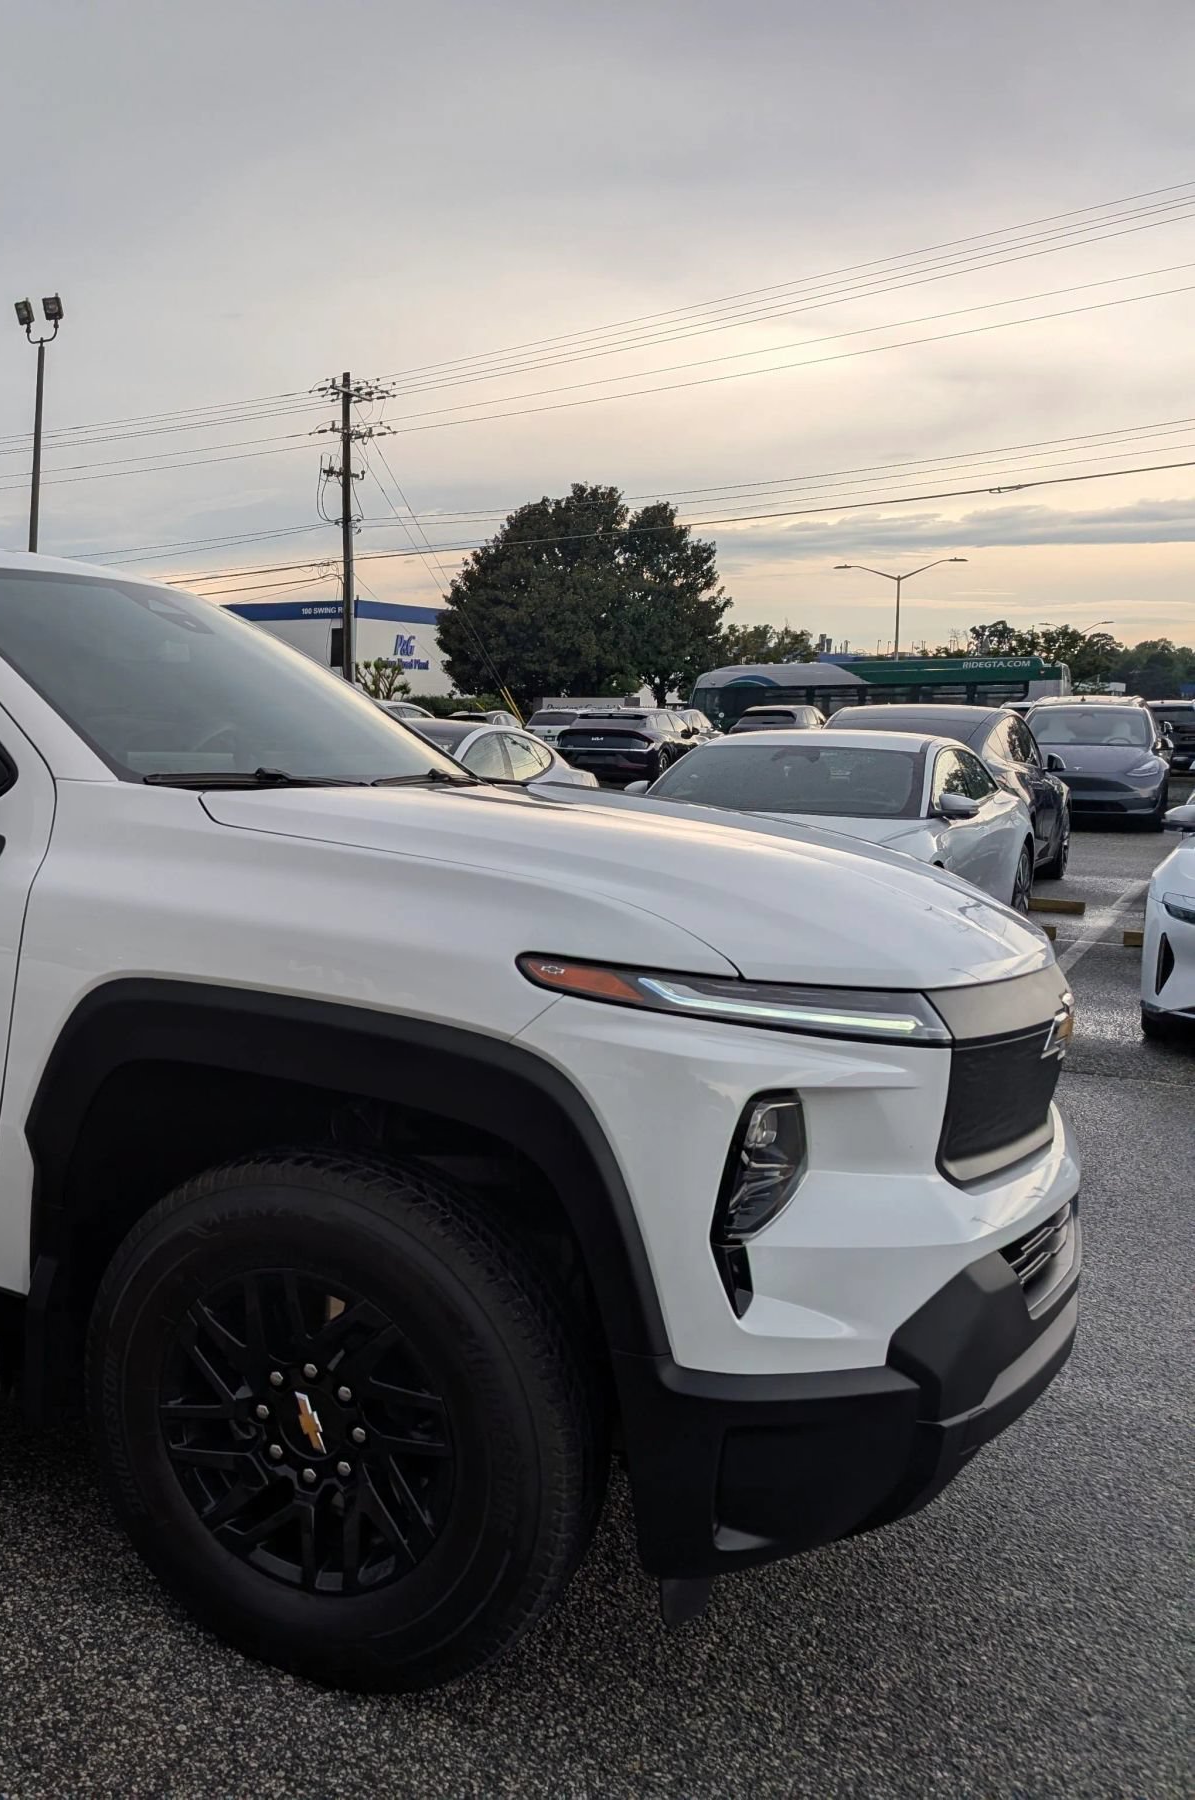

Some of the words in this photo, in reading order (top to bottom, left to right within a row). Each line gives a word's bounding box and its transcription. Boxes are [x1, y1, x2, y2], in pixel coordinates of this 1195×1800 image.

[301, 607, 313, 615] 100
[313, 606, 337, 614] SWING
[393, 634, 416, 656] P&G
[962, 660, 1031, 669] RIDEGTA.COM
